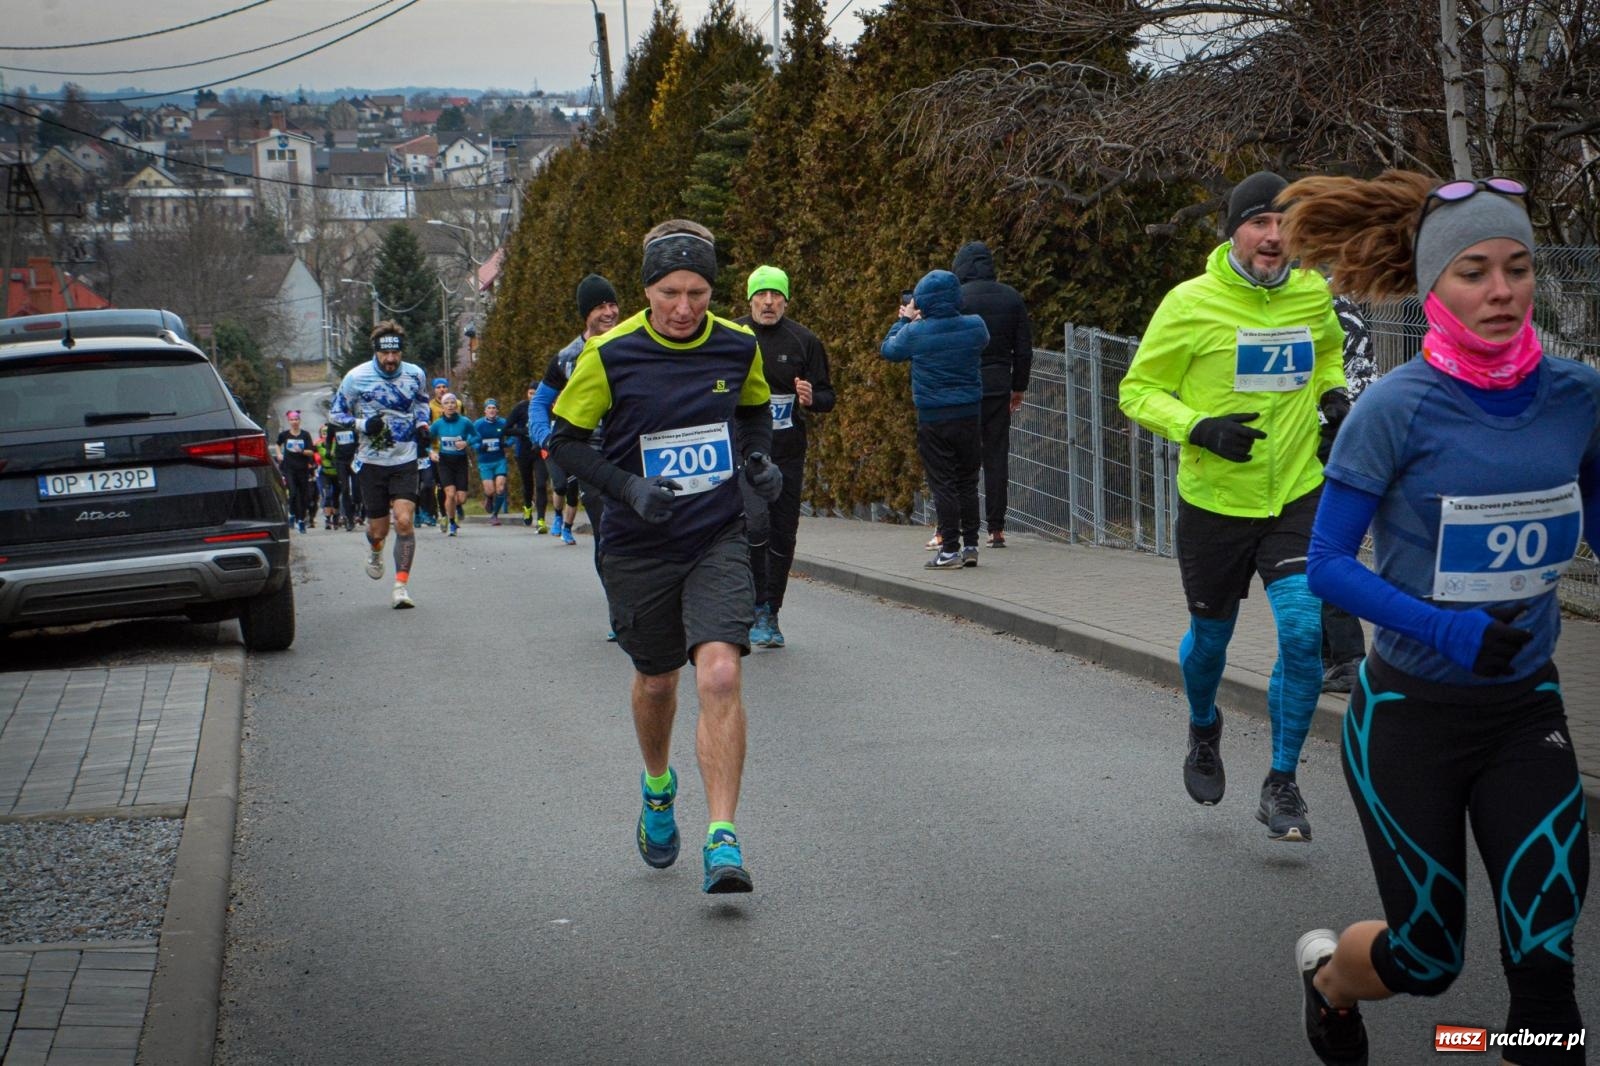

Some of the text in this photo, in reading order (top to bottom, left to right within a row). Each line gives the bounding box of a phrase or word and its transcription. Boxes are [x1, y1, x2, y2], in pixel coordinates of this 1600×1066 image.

[1262, 344, 1296, 372] 71
[659, 443, 718, 477] 200
[51, 469, 149, 494] OP 1239P
[75, 510, 131, 522] Ateca
[1486, 521, 1548, 569] 90
